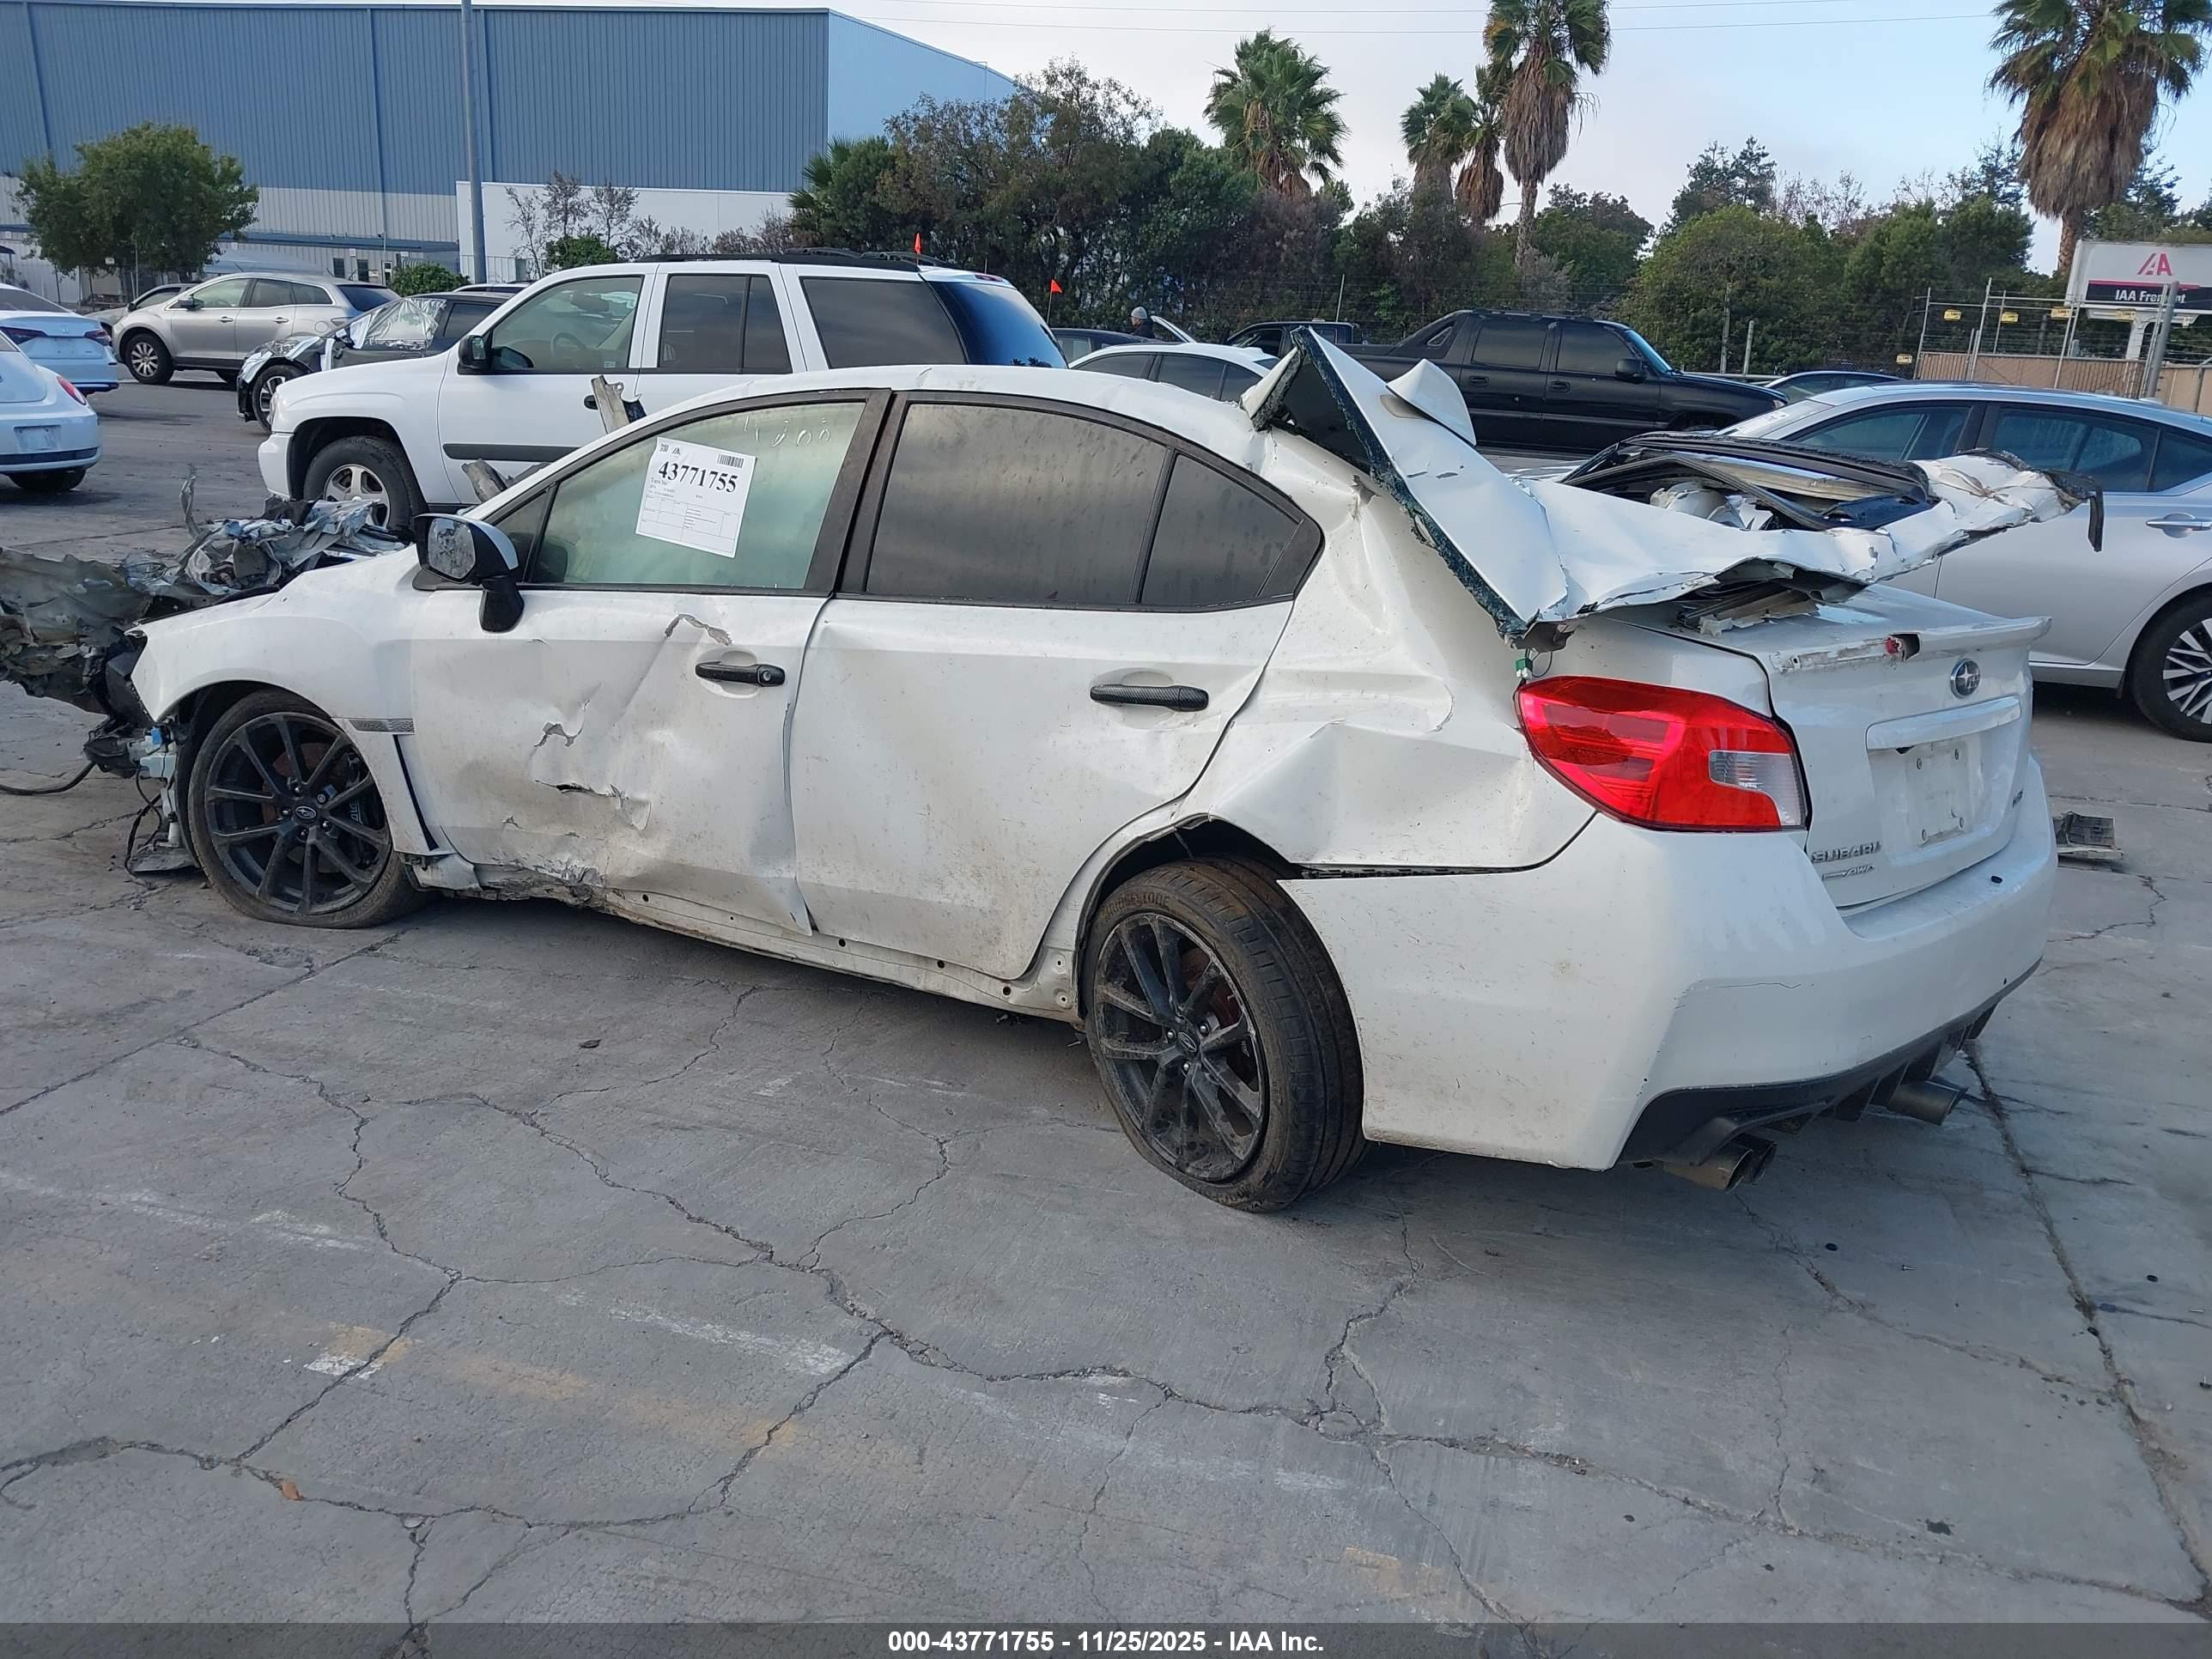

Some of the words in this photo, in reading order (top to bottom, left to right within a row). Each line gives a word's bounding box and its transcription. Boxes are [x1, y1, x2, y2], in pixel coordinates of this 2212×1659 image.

[2115, 289, 2136, 301] IAA
[658, 460, 738, 493] 43771755
[1812, 841, 1882, 863] SUBARU
